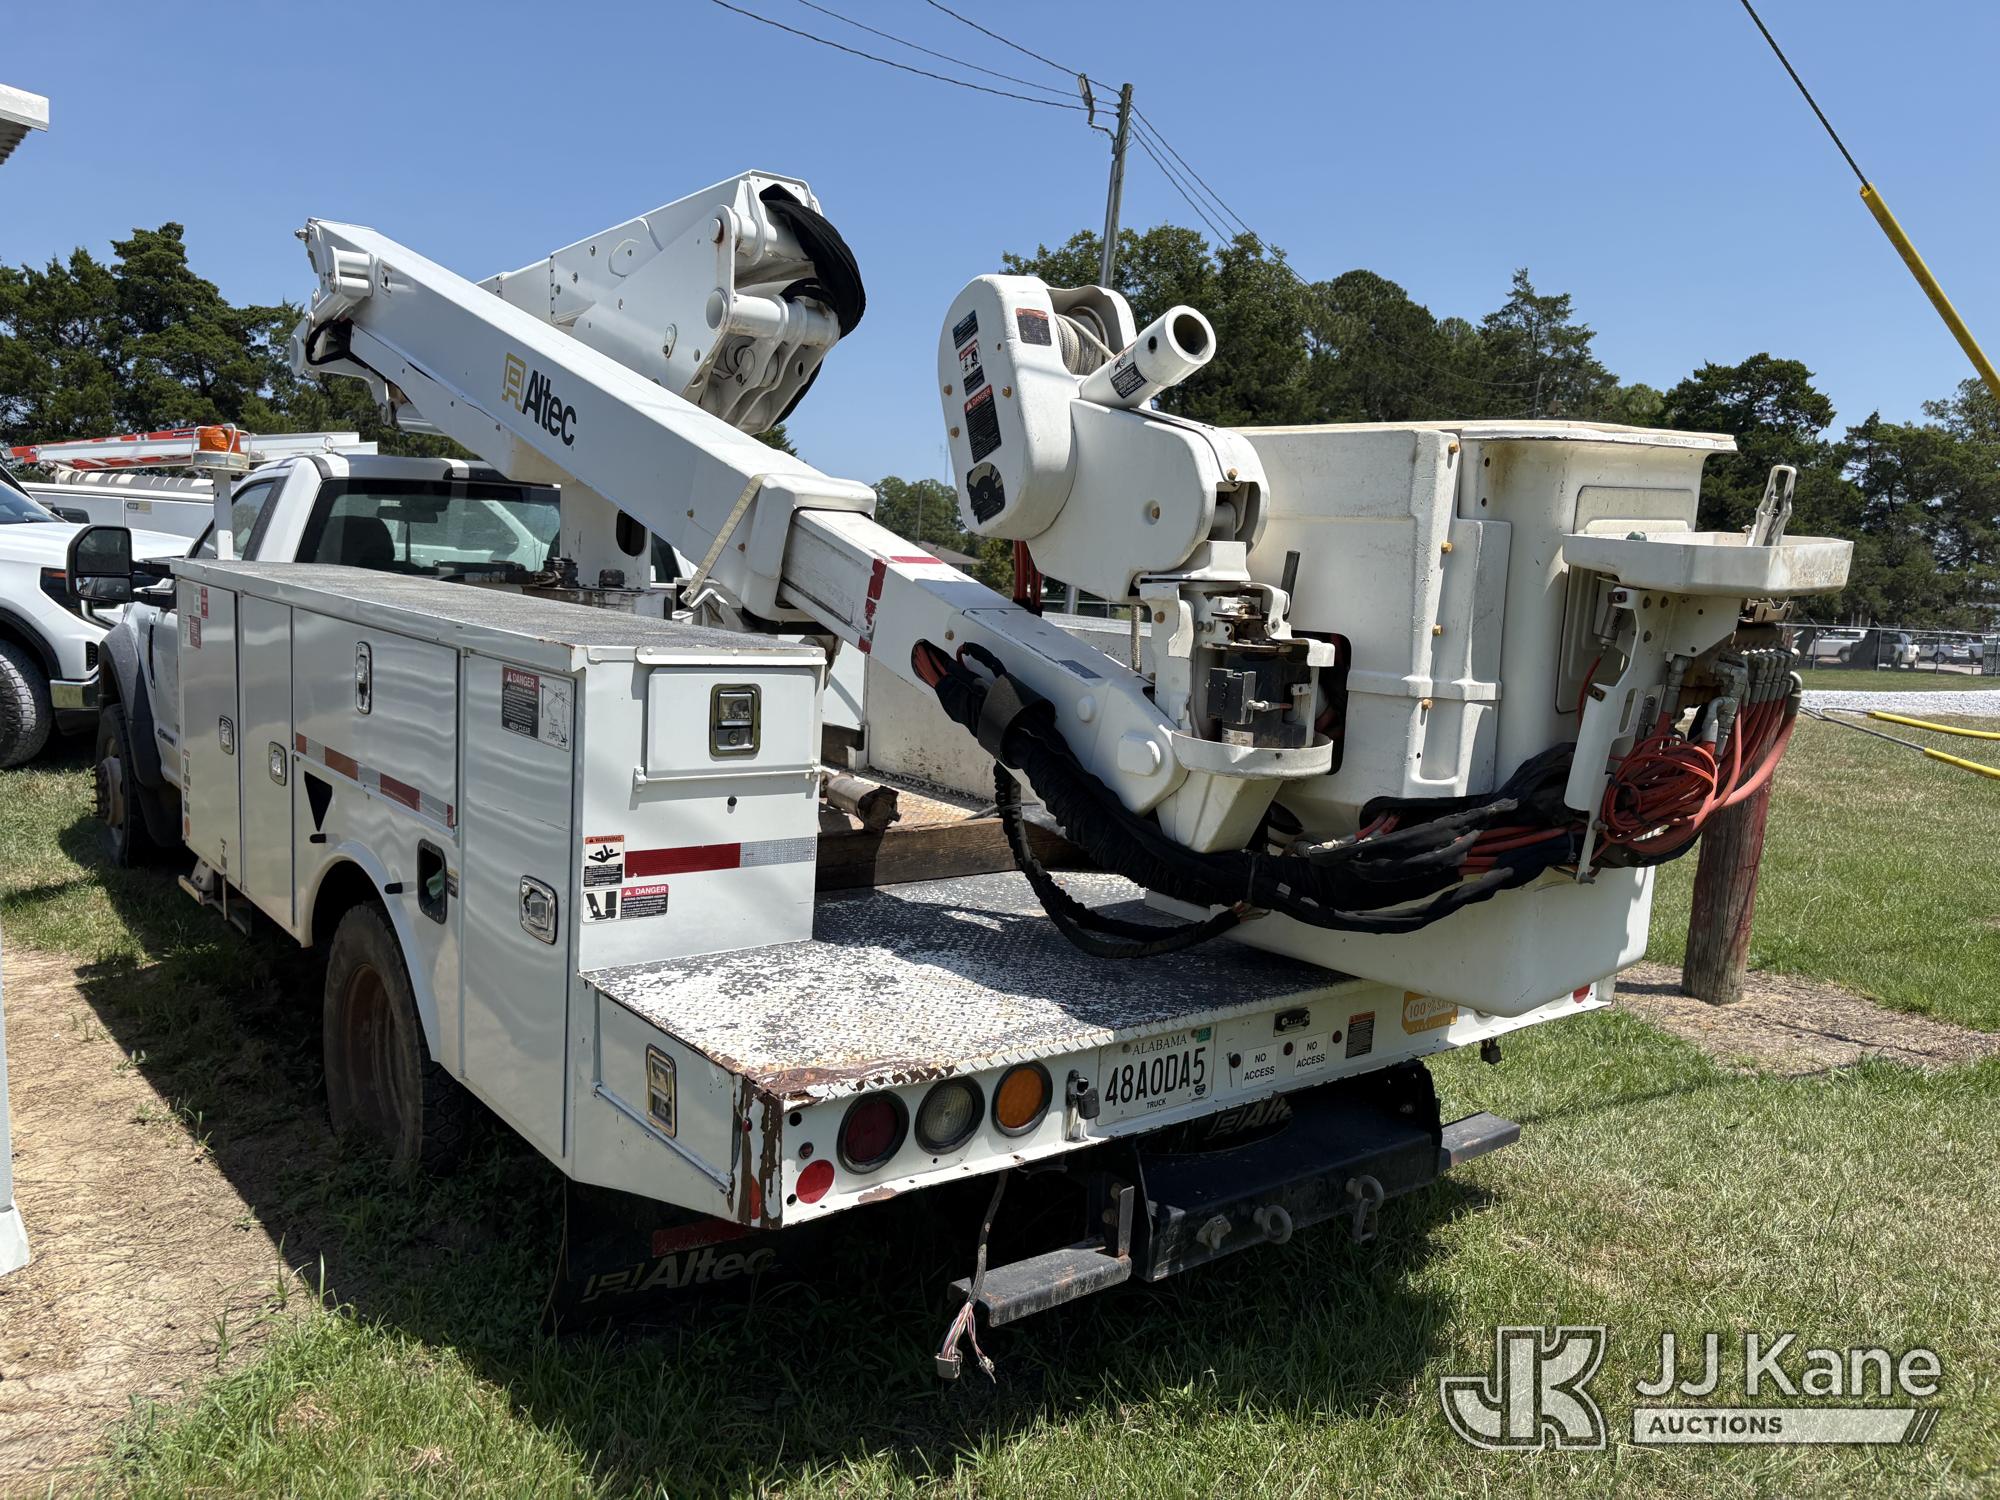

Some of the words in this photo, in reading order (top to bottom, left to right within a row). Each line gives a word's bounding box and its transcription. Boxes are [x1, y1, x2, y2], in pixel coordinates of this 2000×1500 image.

[522, 369, 577, 447] Altec
[512, 673, 535, 688] DANGER
[635, 885, 667, 895] DANGER
[1132, 1034, 1188, 1055] ALABAMA
[1306, 1040, 1318, 1051] NO
[1254, 1052, 1267, 1064] NO
[1296, 1053, 1326, 1068] ACCESS
[1244, 1065, 1275, 1081] ACCESS
[1146, 1097, 1166, 1110] TRUCK
[637, 1247, 776, 1291] Altec
